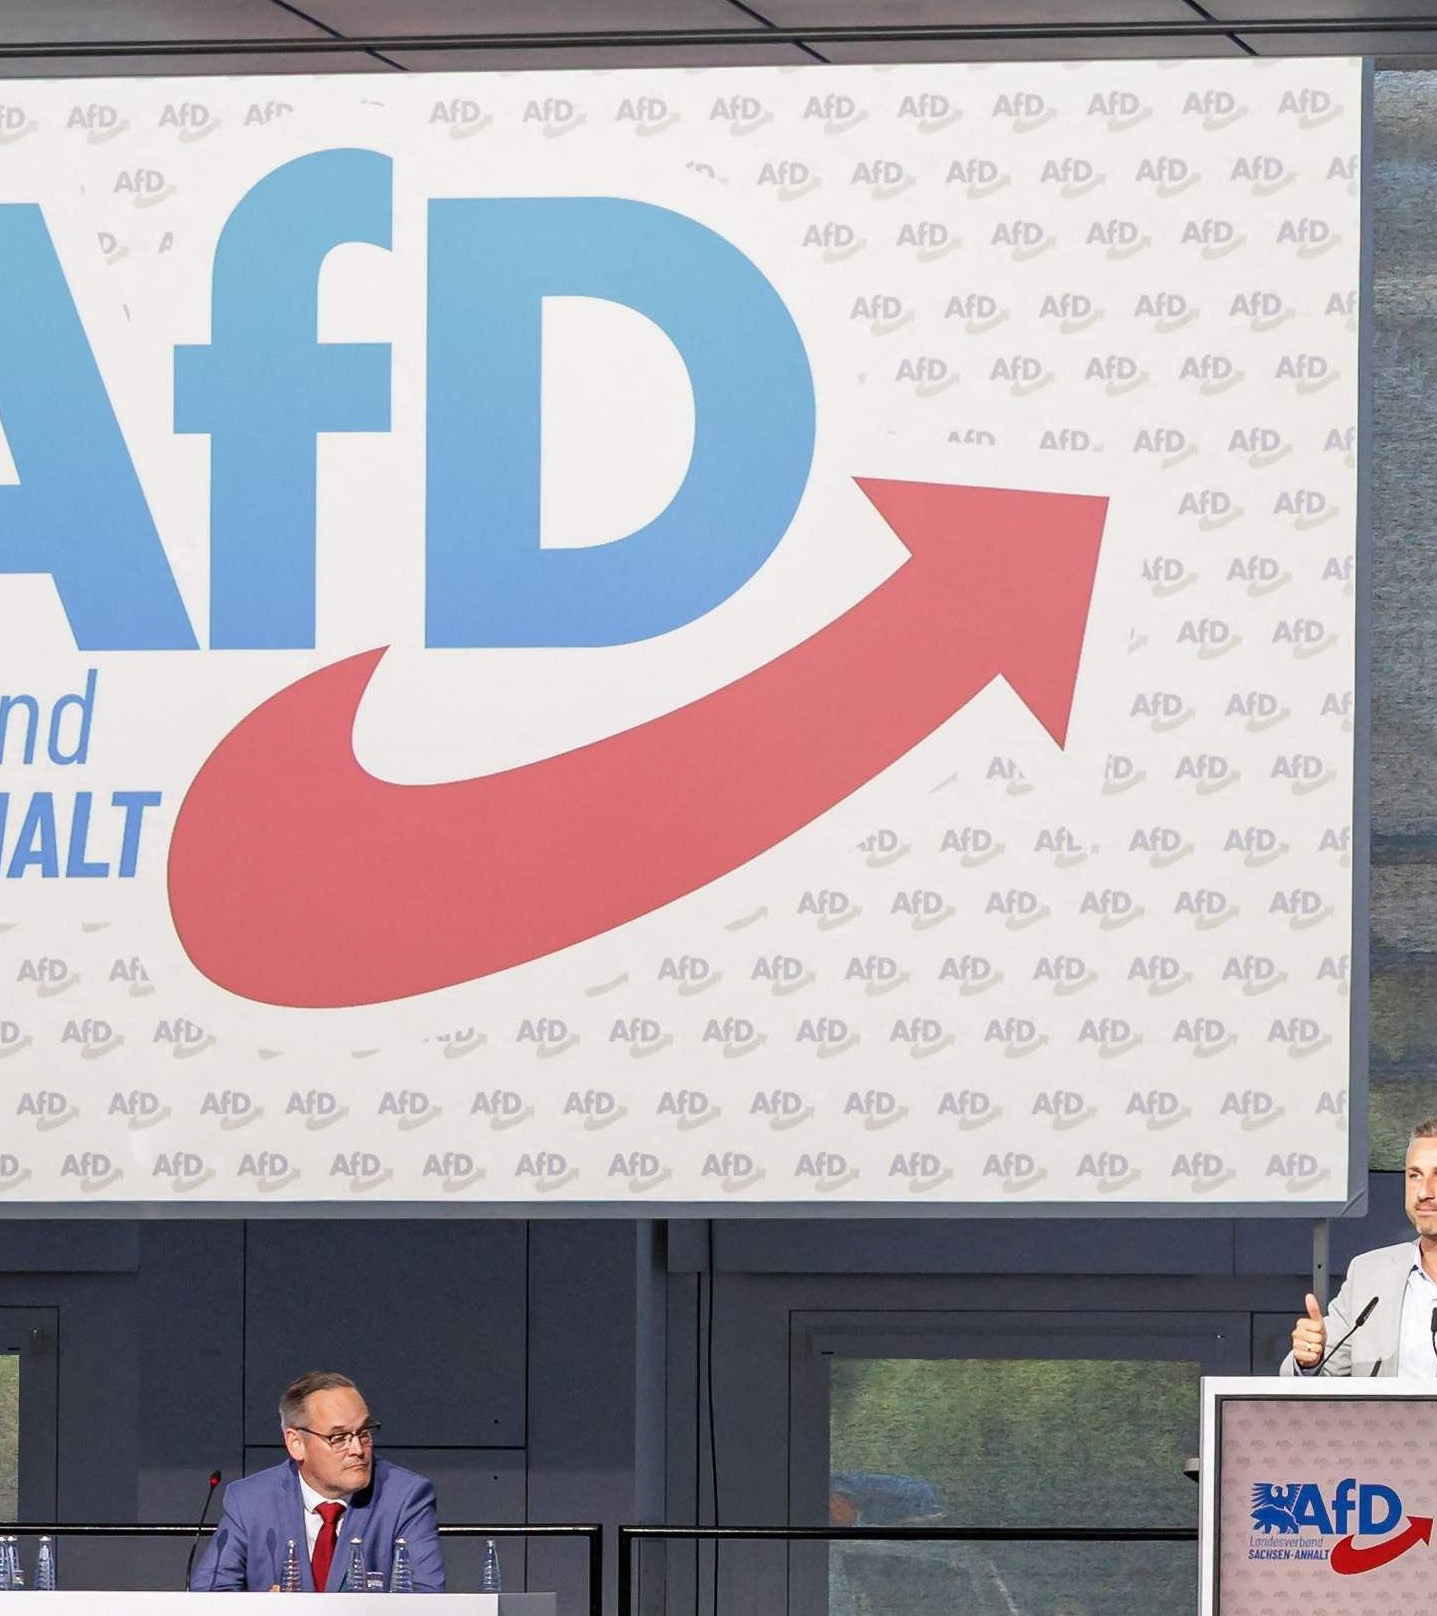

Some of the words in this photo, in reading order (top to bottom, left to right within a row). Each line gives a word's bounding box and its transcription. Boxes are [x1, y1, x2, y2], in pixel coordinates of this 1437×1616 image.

[430, 99, 479, 123] AfD
[523, 98, 572, 122] AfD
[617, 97, 666, 121] AfD
[805, 95, 854, 119] AfD
[899, 94, 948, 118] AfD
[994, 92, 1043, 116] AfD
[1184, 90, 1233, 114] AfD
[1280, 89, 1329, 113] AfD
[159, 103, 208, 127] AfD
[758, 161, 807, 185] AfD
[853, 160, 902, 184] AfD
[947, 159, 996, 183] AfD
[1042, 158, 1091, 182] AfD
[1232, 156, 1281, 180] AfD
[114, 169, 163, 193] AfD
[898, 222, 947, 246] AfD
[992, 221, 1041, 245] AfD
[1087, 220, 1136, 244] AfD
[1278, 219, 1327, 243] AfD
[851, 295, 900, 319] AfD
[946, 294, 995, 318] AfD
[1136, 293, 1185, 317] AfD
[1231, 292, 1280, 316] AfD
[897, 357, 946, 381] AfD
[991, 356, 1040, 380] AfD
[1181, 355, 1230, 379] AfD
[1277, 354, 1326, 378] AfD
[1039, 428, 1088, 452] AfD
[1230, 428, 1279, 452] AfD
[1180, 490, 1229, 514] AfD
[1228, 557, 1277, 581] AfD
[1178, 619, 1227, 643] AfD
[1274, 619, 1323, 643] AfD
[1132, 692, 1181, 716] AfD
[1227, 692, 1276, 716] AfD
[1177, 755, 1226, 779] AfD
[1130, 828, 1179, 852] AfD
[1225, 827, 1274, 851] AfD
[892, 890, 941, 914] AfD
[986, 890, 1035, 914] AfD
[1081, 890, 1130, 914] AfD
[1176, 890, 1225, 914] AfD
[18, 958, 67, 982] AfD
[752, 956, 801, 980] AfD
[846, 956, 895, 980] AfD
[940, 956, 989, 980] AfD
[1034, 956, 1083, 980] AfD
[1224, 956, 1273, 980] AfD
[62, 1019, 111, 1043] AfD
[154, 1019, 203, 1043] AfD
[517, 1018, 566, 1042] AfD
[703, 1018, 752, 1042] AfD
[797, 1018, 846, 1042] AfD
[891, 1018, 940, 1042] AfD
[985, 1018, 1034, 1042] AfD
[1174, 1018, 1223, 1042] AfD
[1269, 1018, 1318, 1042] AfD
[17, 1091, 66, 1115] AfD
[109, 1091, 158, 1115] AfD
[286, 1091, 335, 1115] AfD
[379, 1090, 428, 1114] AfD
[471, 1090, 520, 1114] AfD
[658, 1090, 707, 1114] AfD
[751, 1090, 800, 1114] AfD
[845, 1090, 894, 1114] AfD
[939, 1091, 988, 1115] AfD
[1127, 1091, 1176, 1115] AfD
[1222, 1090, 1271, 1114] AfD
[61, 1152, 110, 1176] AfD
[153, 1152, 202, 1176] AfD
[331, 1152, 380, 1176] AfD
[423, 1152, 472, 1176] AfD
[516, 1152, 565, 1176] AfD
[609, 1152, 658, 1176] AfD
[796, 1152, 845, 1176] AfD
[890, 1153, 939, 1177] AfD
[984, 1152, 1033, 1176] AfD
[1172, 1153, 1221, 1177] AfD
[1267, 1153, 1316, 1177] AfD
[1292, 1478, 1403, 1535] AfD
[1249, 1535, 1324, 1548] Landesverband
[1248, 1549, 1330, 1560] SACHSEN-ANHALT
